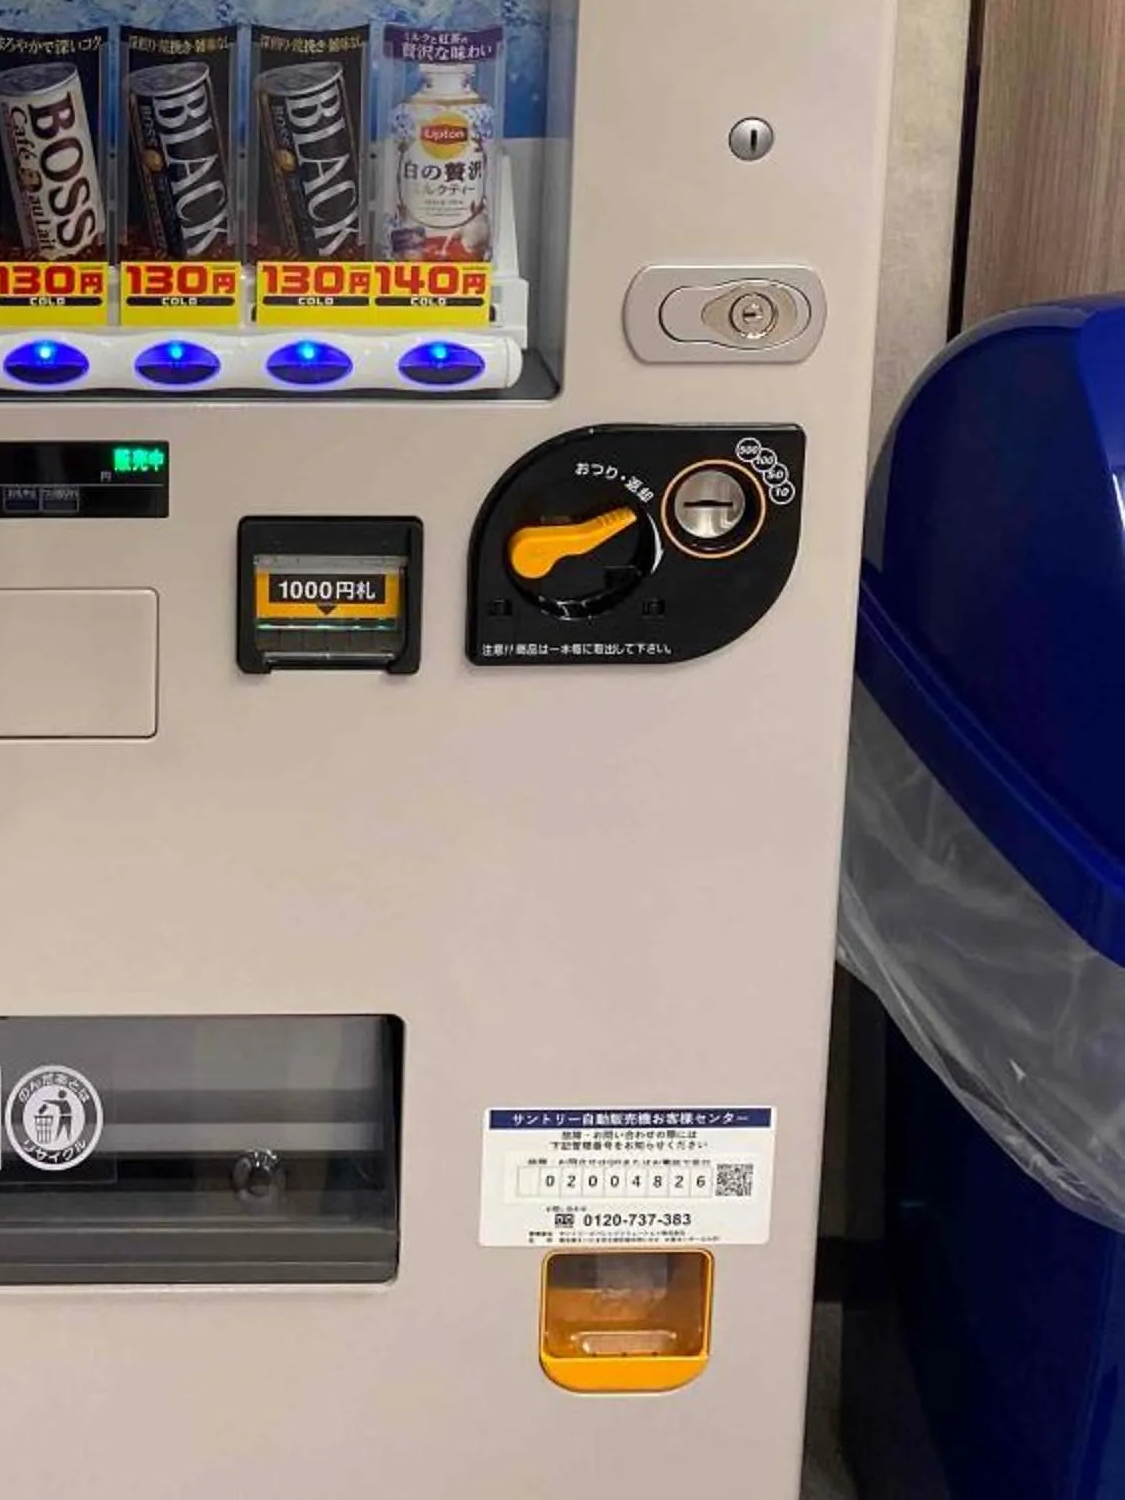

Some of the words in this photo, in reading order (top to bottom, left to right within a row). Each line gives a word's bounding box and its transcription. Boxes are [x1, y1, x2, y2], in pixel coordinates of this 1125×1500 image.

[401, 44, 492, 62] 贅沢な味わい
[423, 128, 466, 143] Lipton
[27, 91, 97, 249] BOSS
[152, 85, 229, 256] BLACK
[285, 84, 360, 257] BLACK
[403, 160, 482, 182] 白の贅沢
[125, 264, 235, 295] 130円
[263, 264, 370, 295] 130円
[375, 264, 485, 295] 140円
[29, 296, 66, 306] COLD
[161, 296, 198, 306] COLD
[297, 296, 334, 306] COLD
[410, 296, 447, 306] COLD
[755, 455, 774, 466] 100
[767, 468, 785, 480] 50
[775, 486, 790, 497] 10
[278, 580, 376, 600] 1000円札
[18, 1073, 91, 1102] のんだあとは
[511, 1112, 749, 1126] サントリー自動販売機お客様センター
[23, 1138, 87, 1164] リサイクル
[583, 1213, 692, 1227] 0120-737-383
